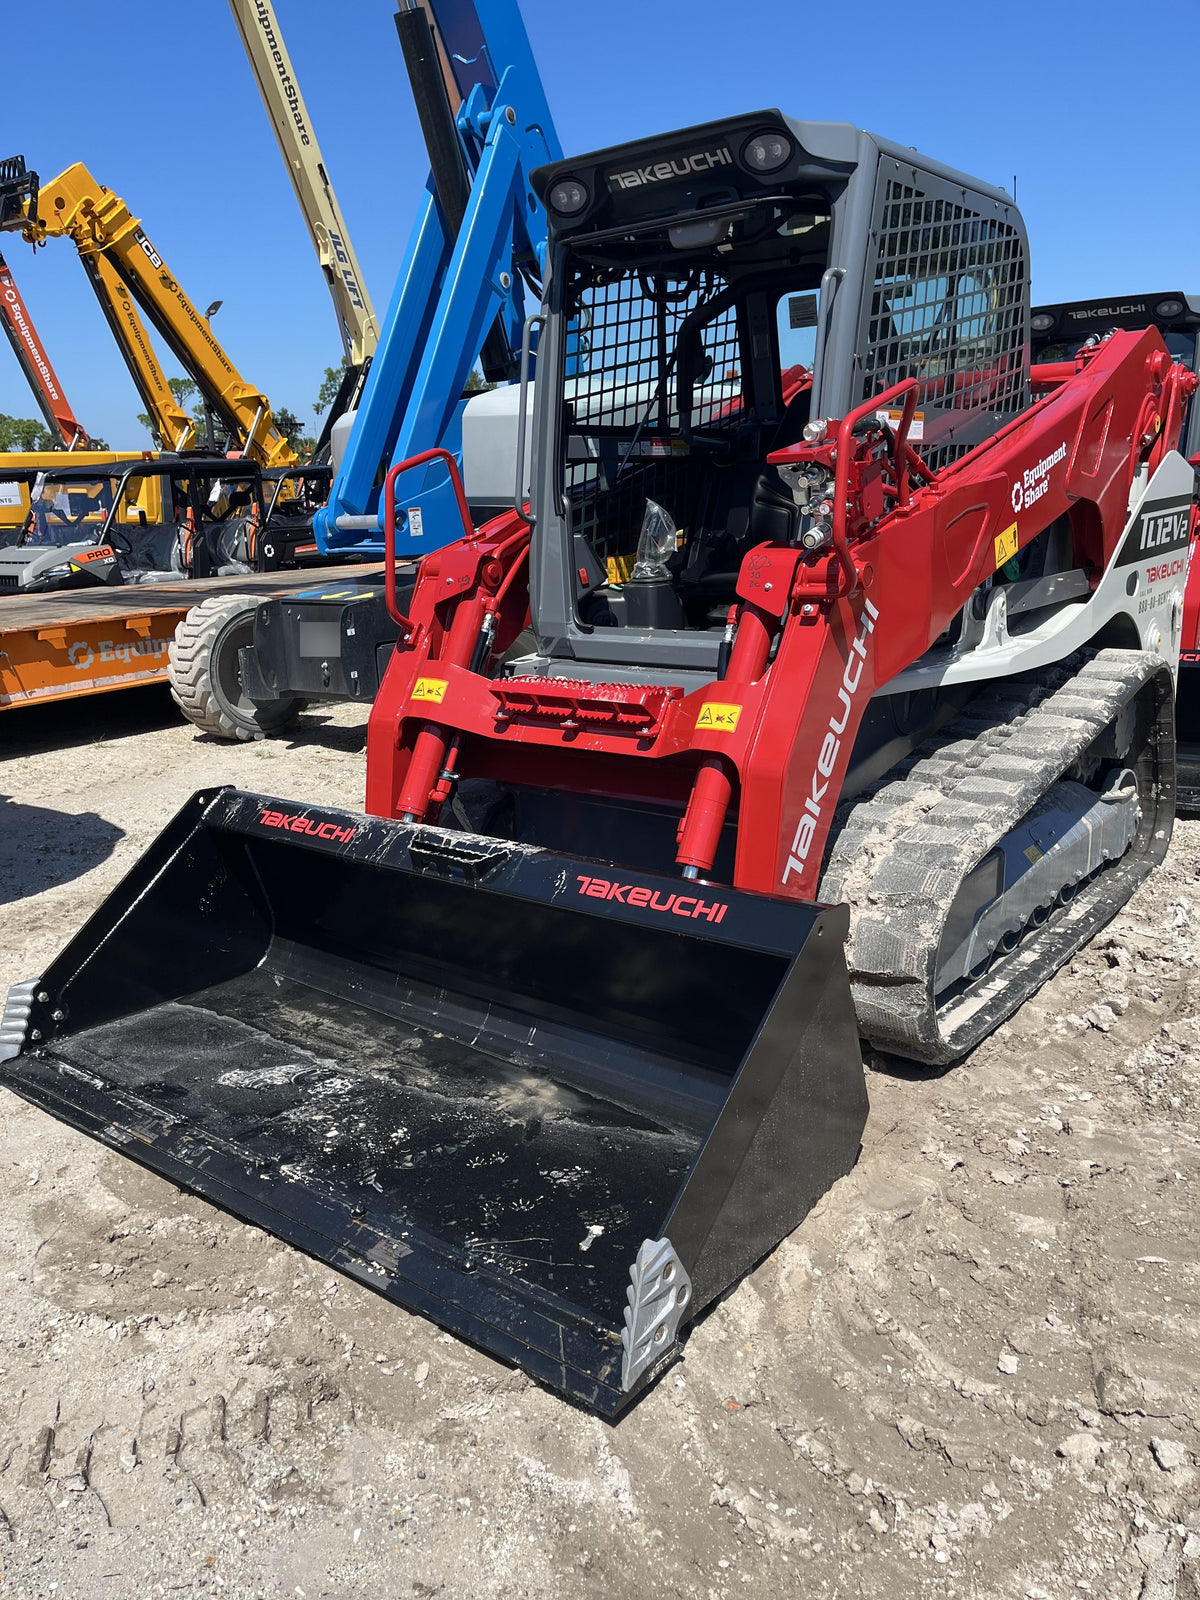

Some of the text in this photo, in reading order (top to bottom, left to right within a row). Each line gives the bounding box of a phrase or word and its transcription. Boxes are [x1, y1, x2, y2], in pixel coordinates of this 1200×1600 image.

[134, 230, 163, 269] JCB
[328, 229, 364, 310] JLG LIFT
[11, 303, 59, 400] EquipmentShare
[127, 312, 163, 391] EquipmentShare
[176, 294, 233, 374] EquipmentShare
[1023, 441, 1067, 489] Equipment
[1024, 479, 1049, 509] Share
[87, 548, 111, 560] PRO
